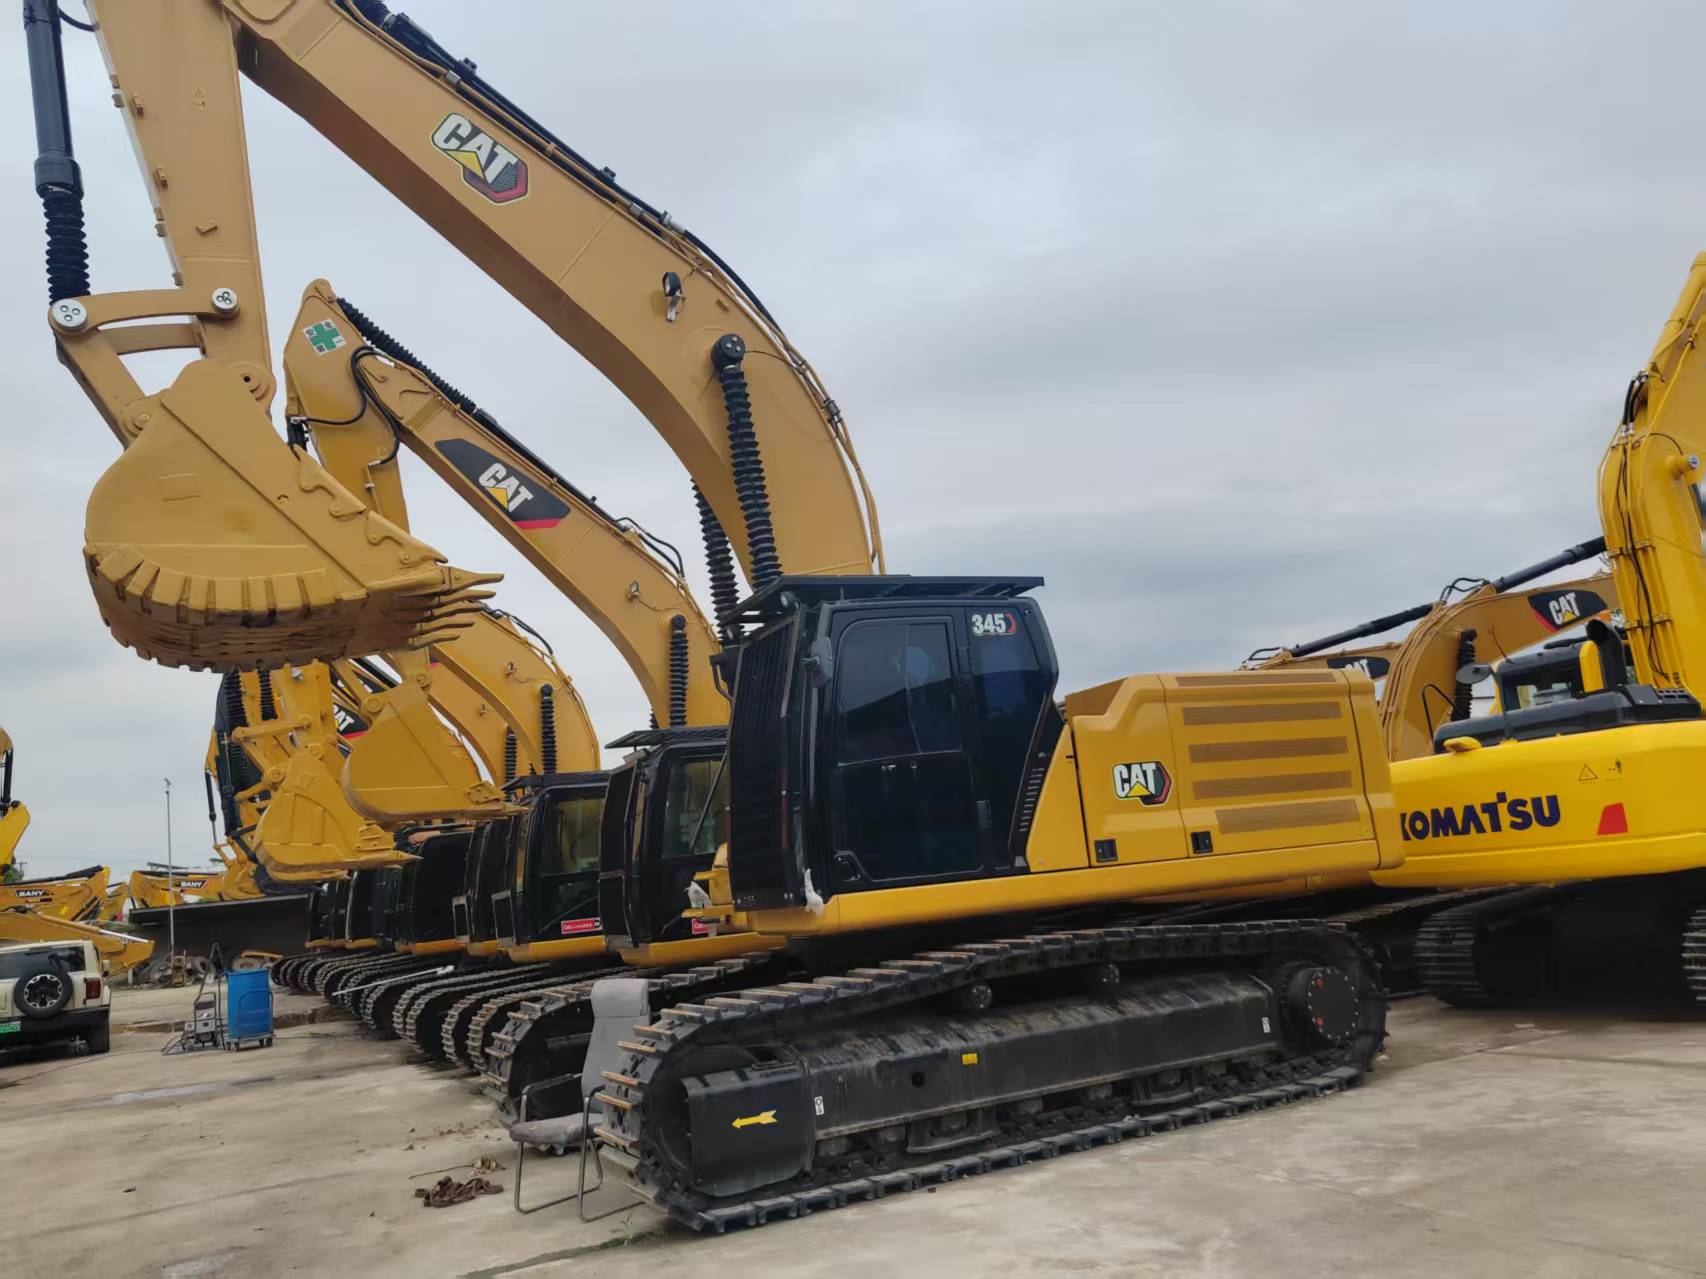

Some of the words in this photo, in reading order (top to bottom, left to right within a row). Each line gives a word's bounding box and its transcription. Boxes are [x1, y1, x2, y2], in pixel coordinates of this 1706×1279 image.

[433, 113, 519, 184] CAT
[479, 463, 534, 512] CAT
[972, 613, 1006, 634] 345
[1549, 592, 1580, 625] CAT
[1113, 763, 1156, 797] CAT
